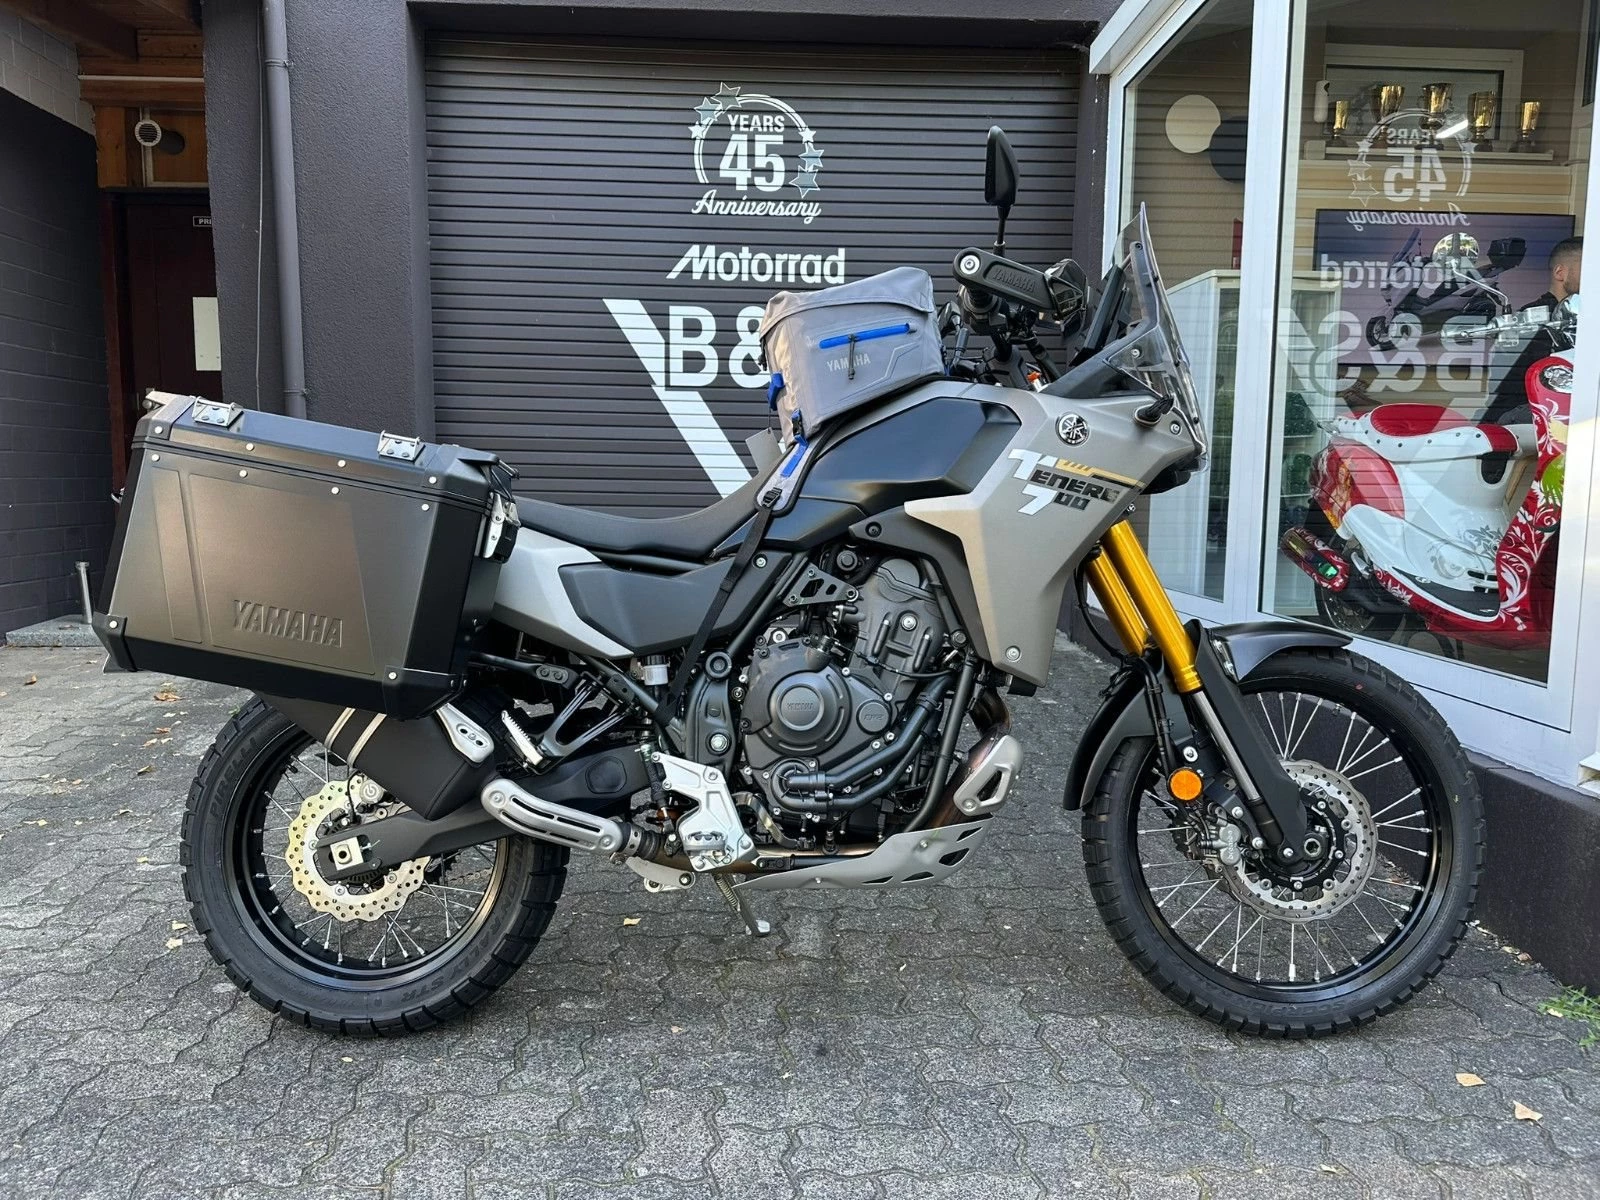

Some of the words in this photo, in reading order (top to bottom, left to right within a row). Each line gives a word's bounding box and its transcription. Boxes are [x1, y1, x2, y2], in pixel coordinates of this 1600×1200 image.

[727, 114, 786, 133] YEARS
[719, 134, 786, 192] 45
[691, 189, 822, 224] Anniversary
[666, 244, 846, 285] Motorrad
[992, 269, 1038, 293] YAMAHA
[826, 353, 871, 372] YAMHA
[233, 599, 343, 649] YAMAHA
